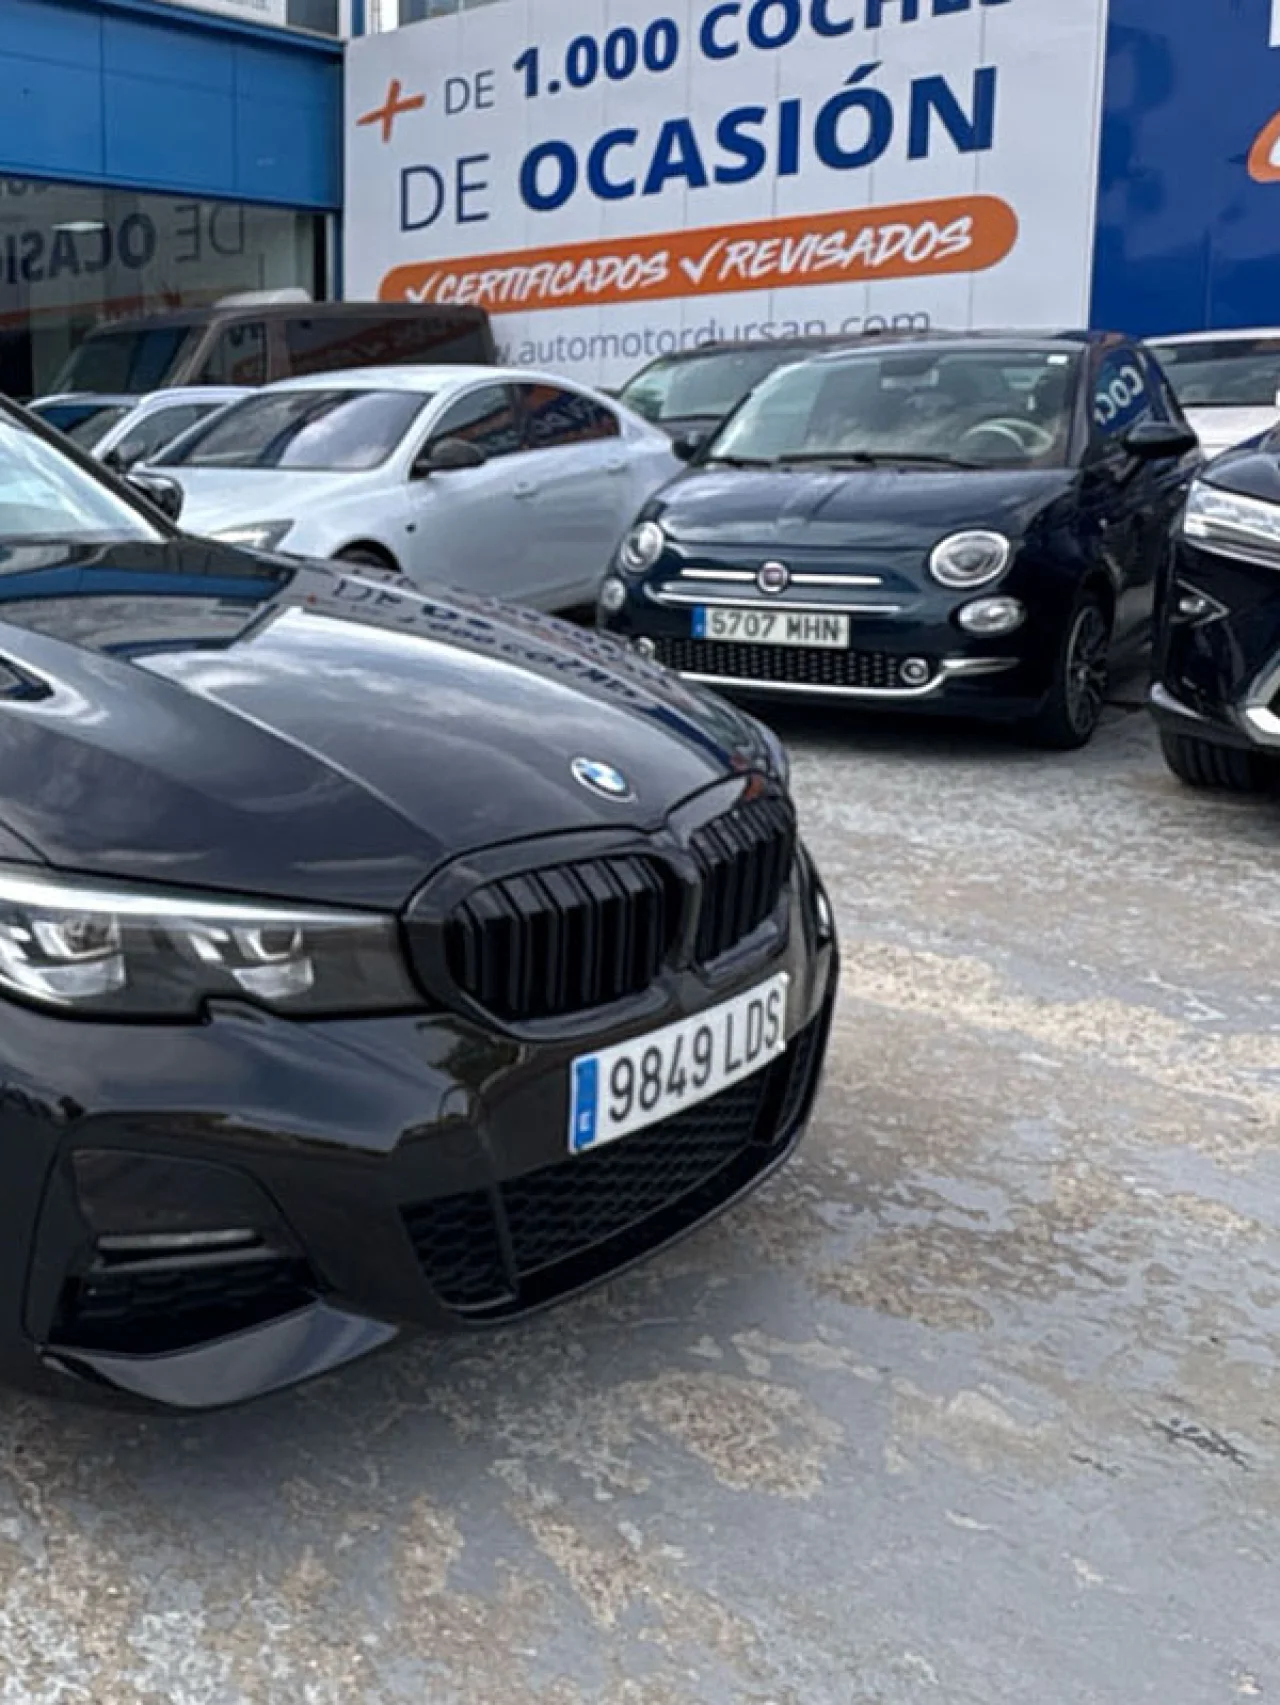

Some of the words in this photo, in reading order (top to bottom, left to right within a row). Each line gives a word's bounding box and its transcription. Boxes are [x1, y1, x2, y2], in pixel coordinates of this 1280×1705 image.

[444, 70, 495, 116] DE
[512, 17, 679, 99] 1.000
[699, 0, 1014, 61] COCH
[400, 154, 490, 233] DE
[519, 61, 998, 212] OCASIÓN
[437, 251, 670, 305] CERTIFICADOS
[717, 215, 975, 282] REVISADOS
[711, 610, 777, 639] 5707
[786, 615, 840, 642] MHN
[608, 1026, 713, 1123] 9849
[724, 990, 781, 1073] LDS
